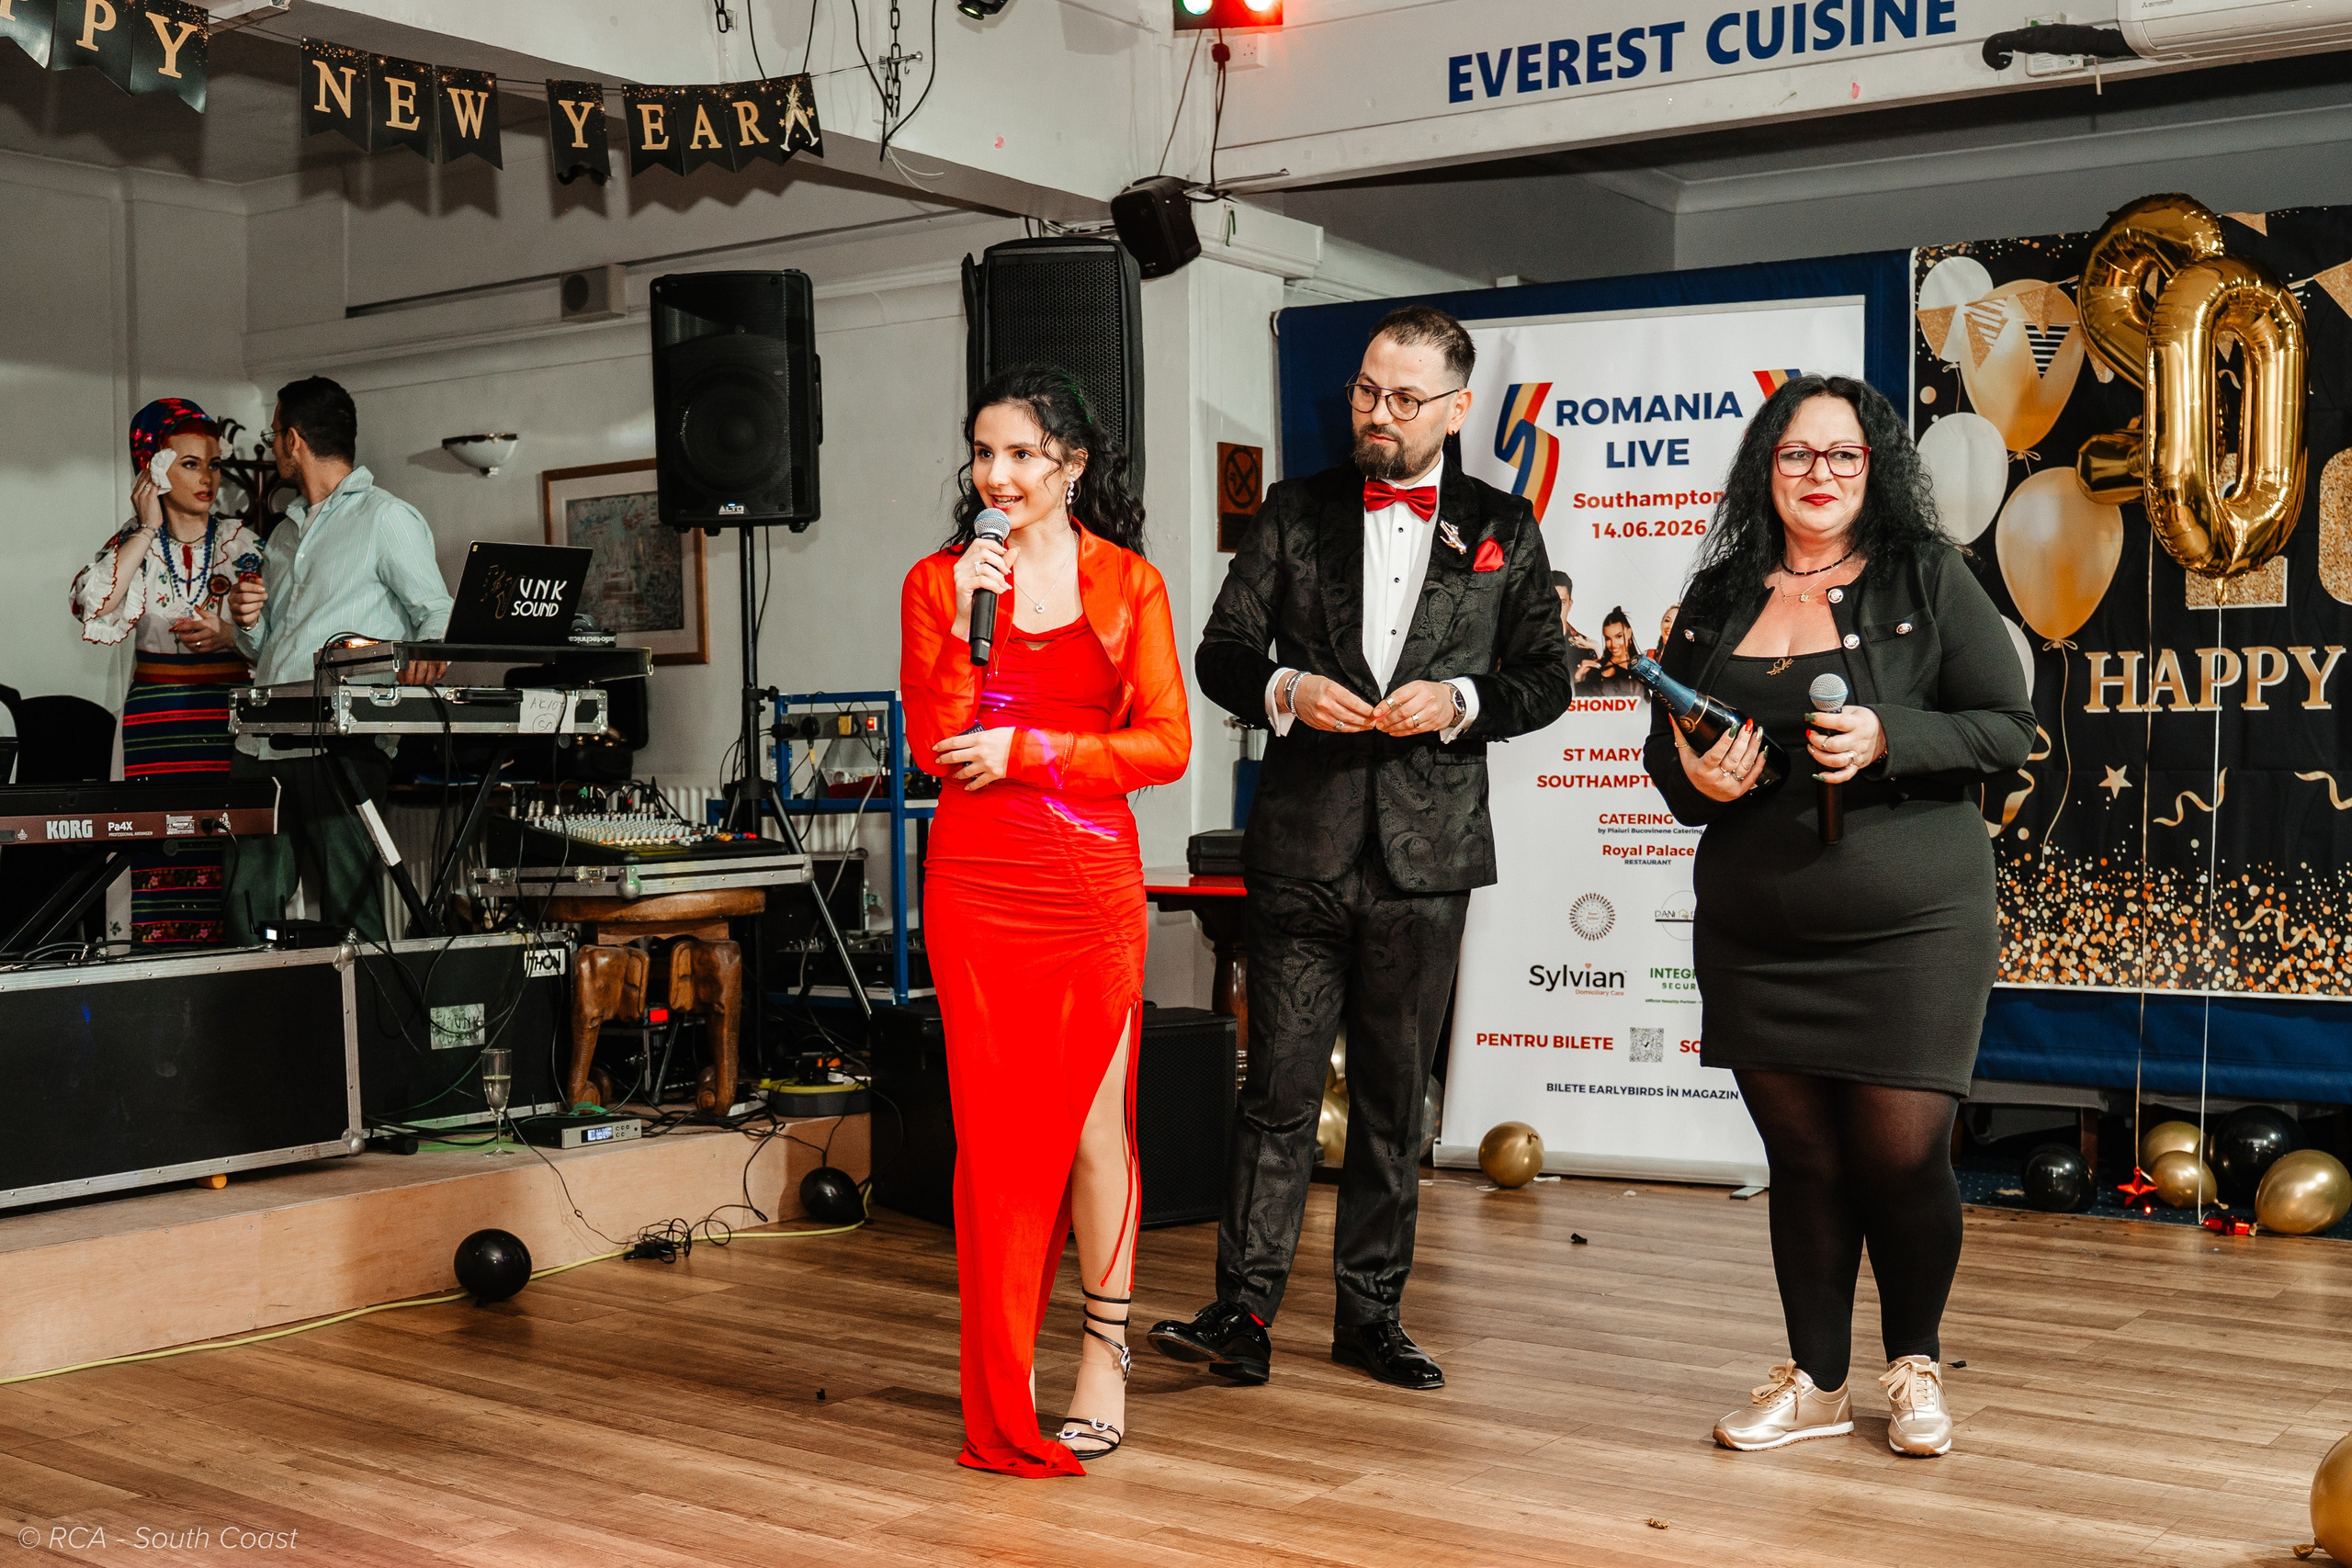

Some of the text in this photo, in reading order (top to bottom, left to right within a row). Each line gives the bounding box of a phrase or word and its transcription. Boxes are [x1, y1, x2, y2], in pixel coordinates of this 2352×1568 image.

[1449, 0, 1958, 104] EVEREST CUISINE
[0, 0, 770, 150] PY NEW YEAR
[1556, 391, 1744, 426] ROMANIA
[1606, 438, 1690, 468] LIVE
[718, 505, 744, 513] ALTO
[1573, 490, 1726, 509] Southampton
[1592, 519, 1707, 539] 14.06.2026
[511, 601, 560, 617] SOUND
[2084, 646, 2346, 713] HAPPY
[1563, 748, 1643, 761] ST MARY
[107, 821, 133, 831] Pa4X
[1599, 813, 1674, 825] CATERING
[46, 819, 93, 840] KORG
[1602, 844, 1695, 858] Royal Palace
[526, 951, 560, 971] THON
[1529, 963, 1624, 992] Sylvian
[1476, 1032, 1548, 1047] PENTRU
[1553, 1035, 1613, 1050] BILETE
[1546, 1083, 1739, 1100] BILETE EARLYBIRDS ÎN MAGAZIN
